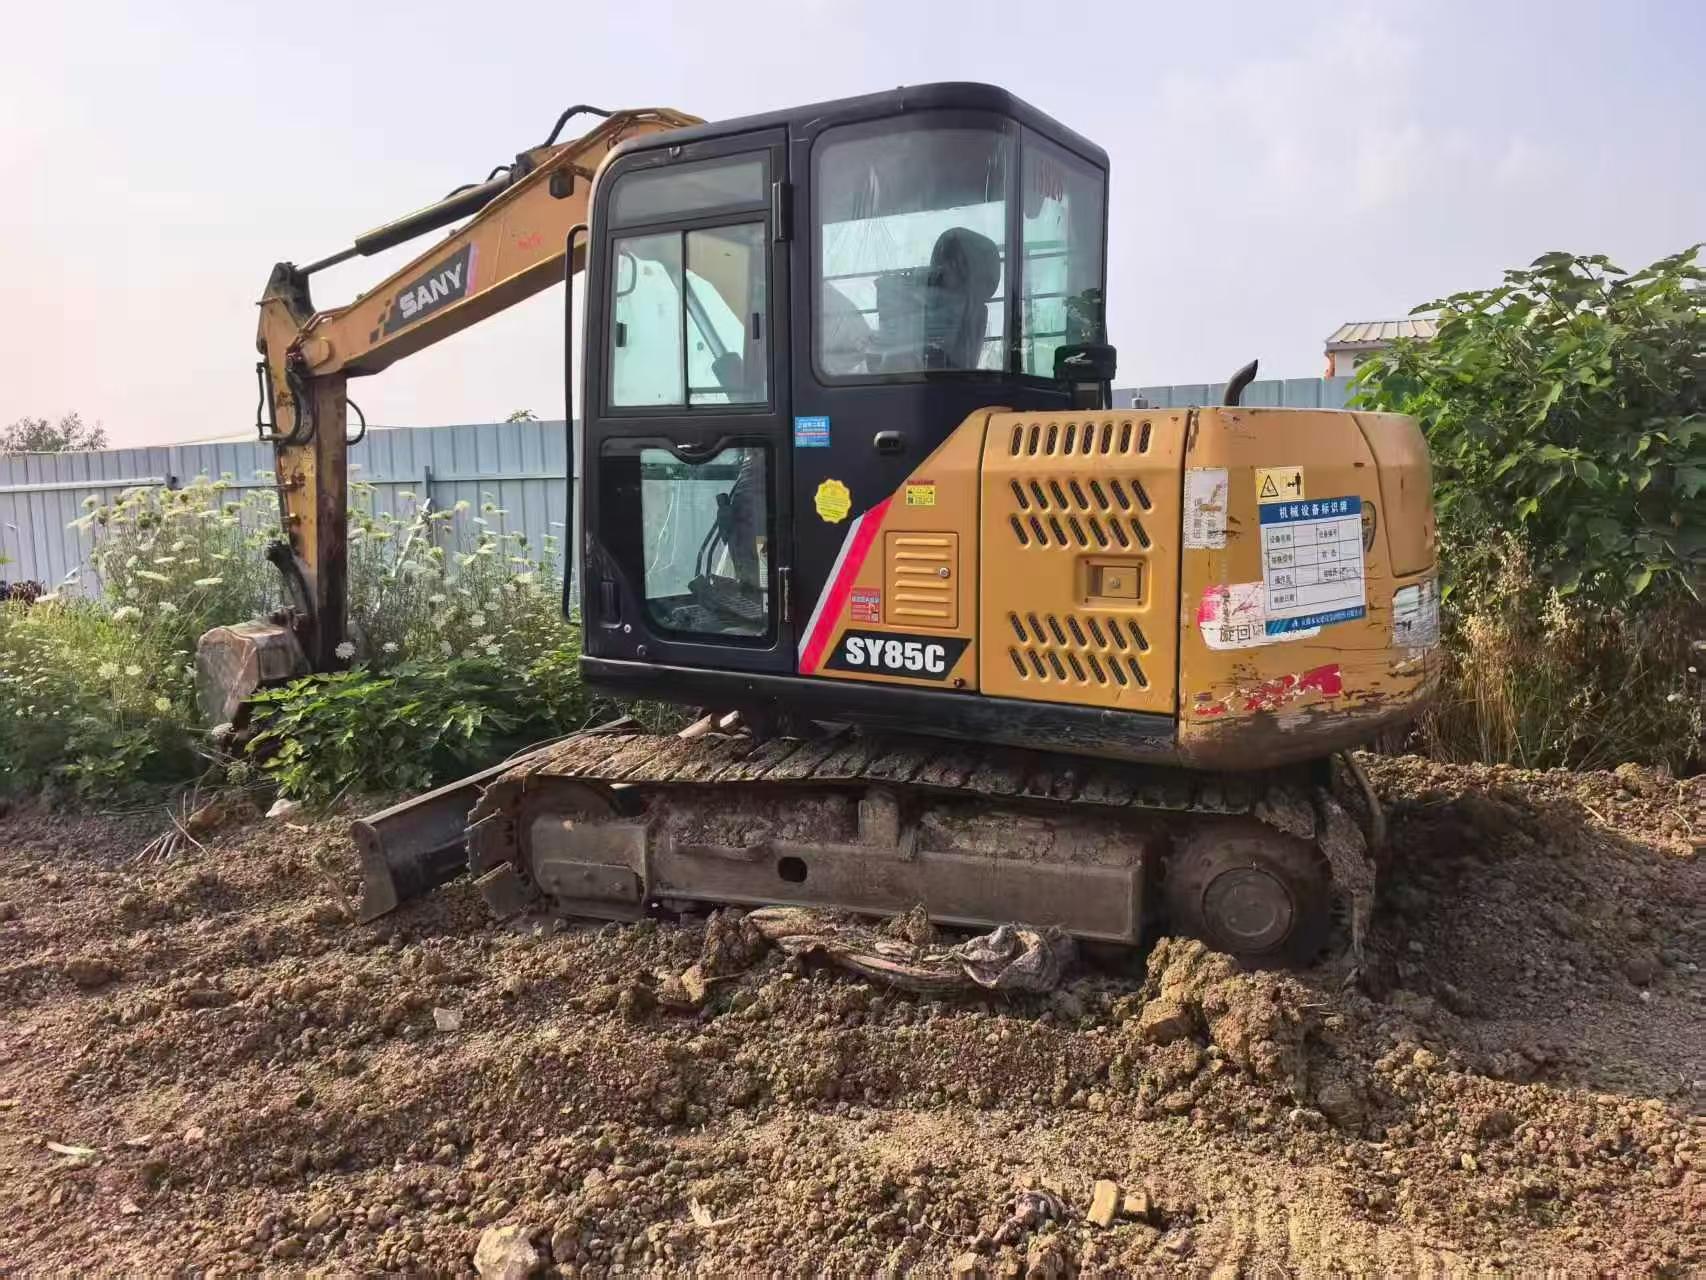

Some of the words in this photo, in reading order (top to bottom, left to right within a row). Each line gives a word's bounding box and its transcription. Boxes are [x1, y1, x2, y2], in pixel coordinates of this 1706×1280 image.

[399, 262, 462, 319] SANY
[1279, 501, 1347, 519] 机械设备标识牌
[845, 637, 945, 673] SY85C
